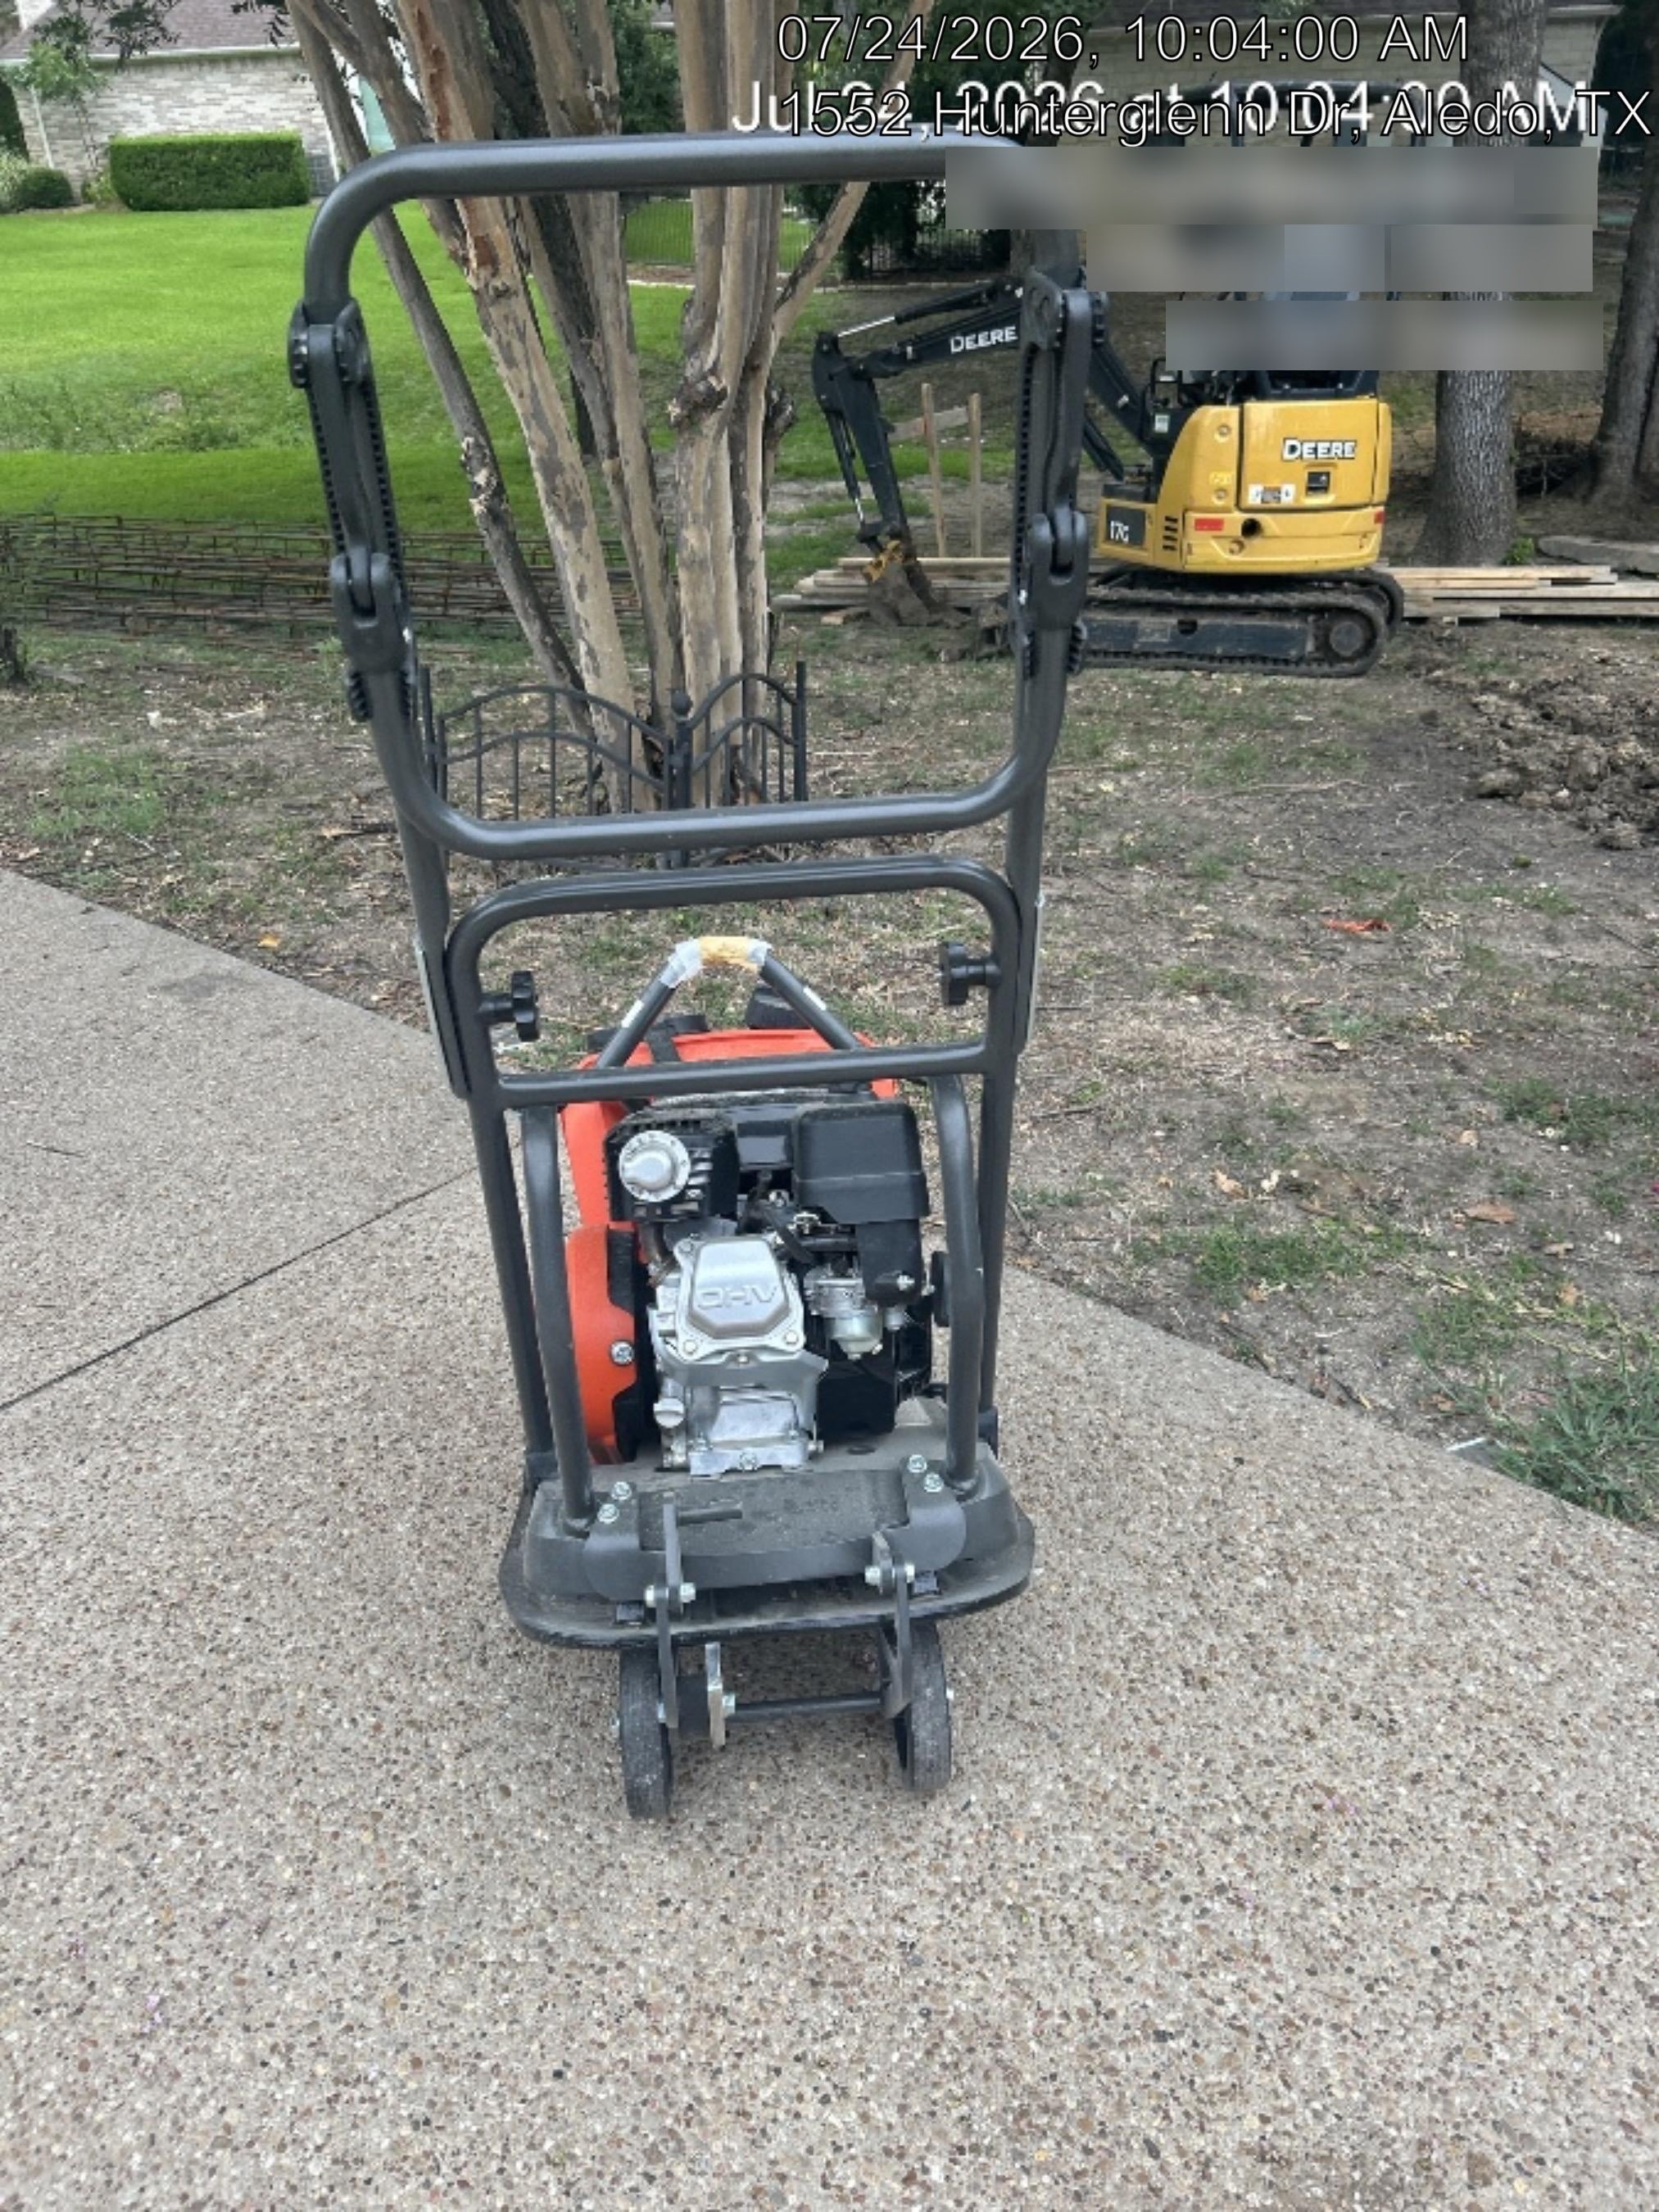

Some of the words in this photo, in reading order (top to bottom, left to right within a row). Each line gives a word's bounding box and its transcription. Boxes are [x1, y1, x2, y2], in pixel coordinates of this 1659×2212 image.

[950, 326, 1018, 354] DEERE
[1282, 437, 1357, 460] DEERE
[697, 1285, 777, 1309] OHV
